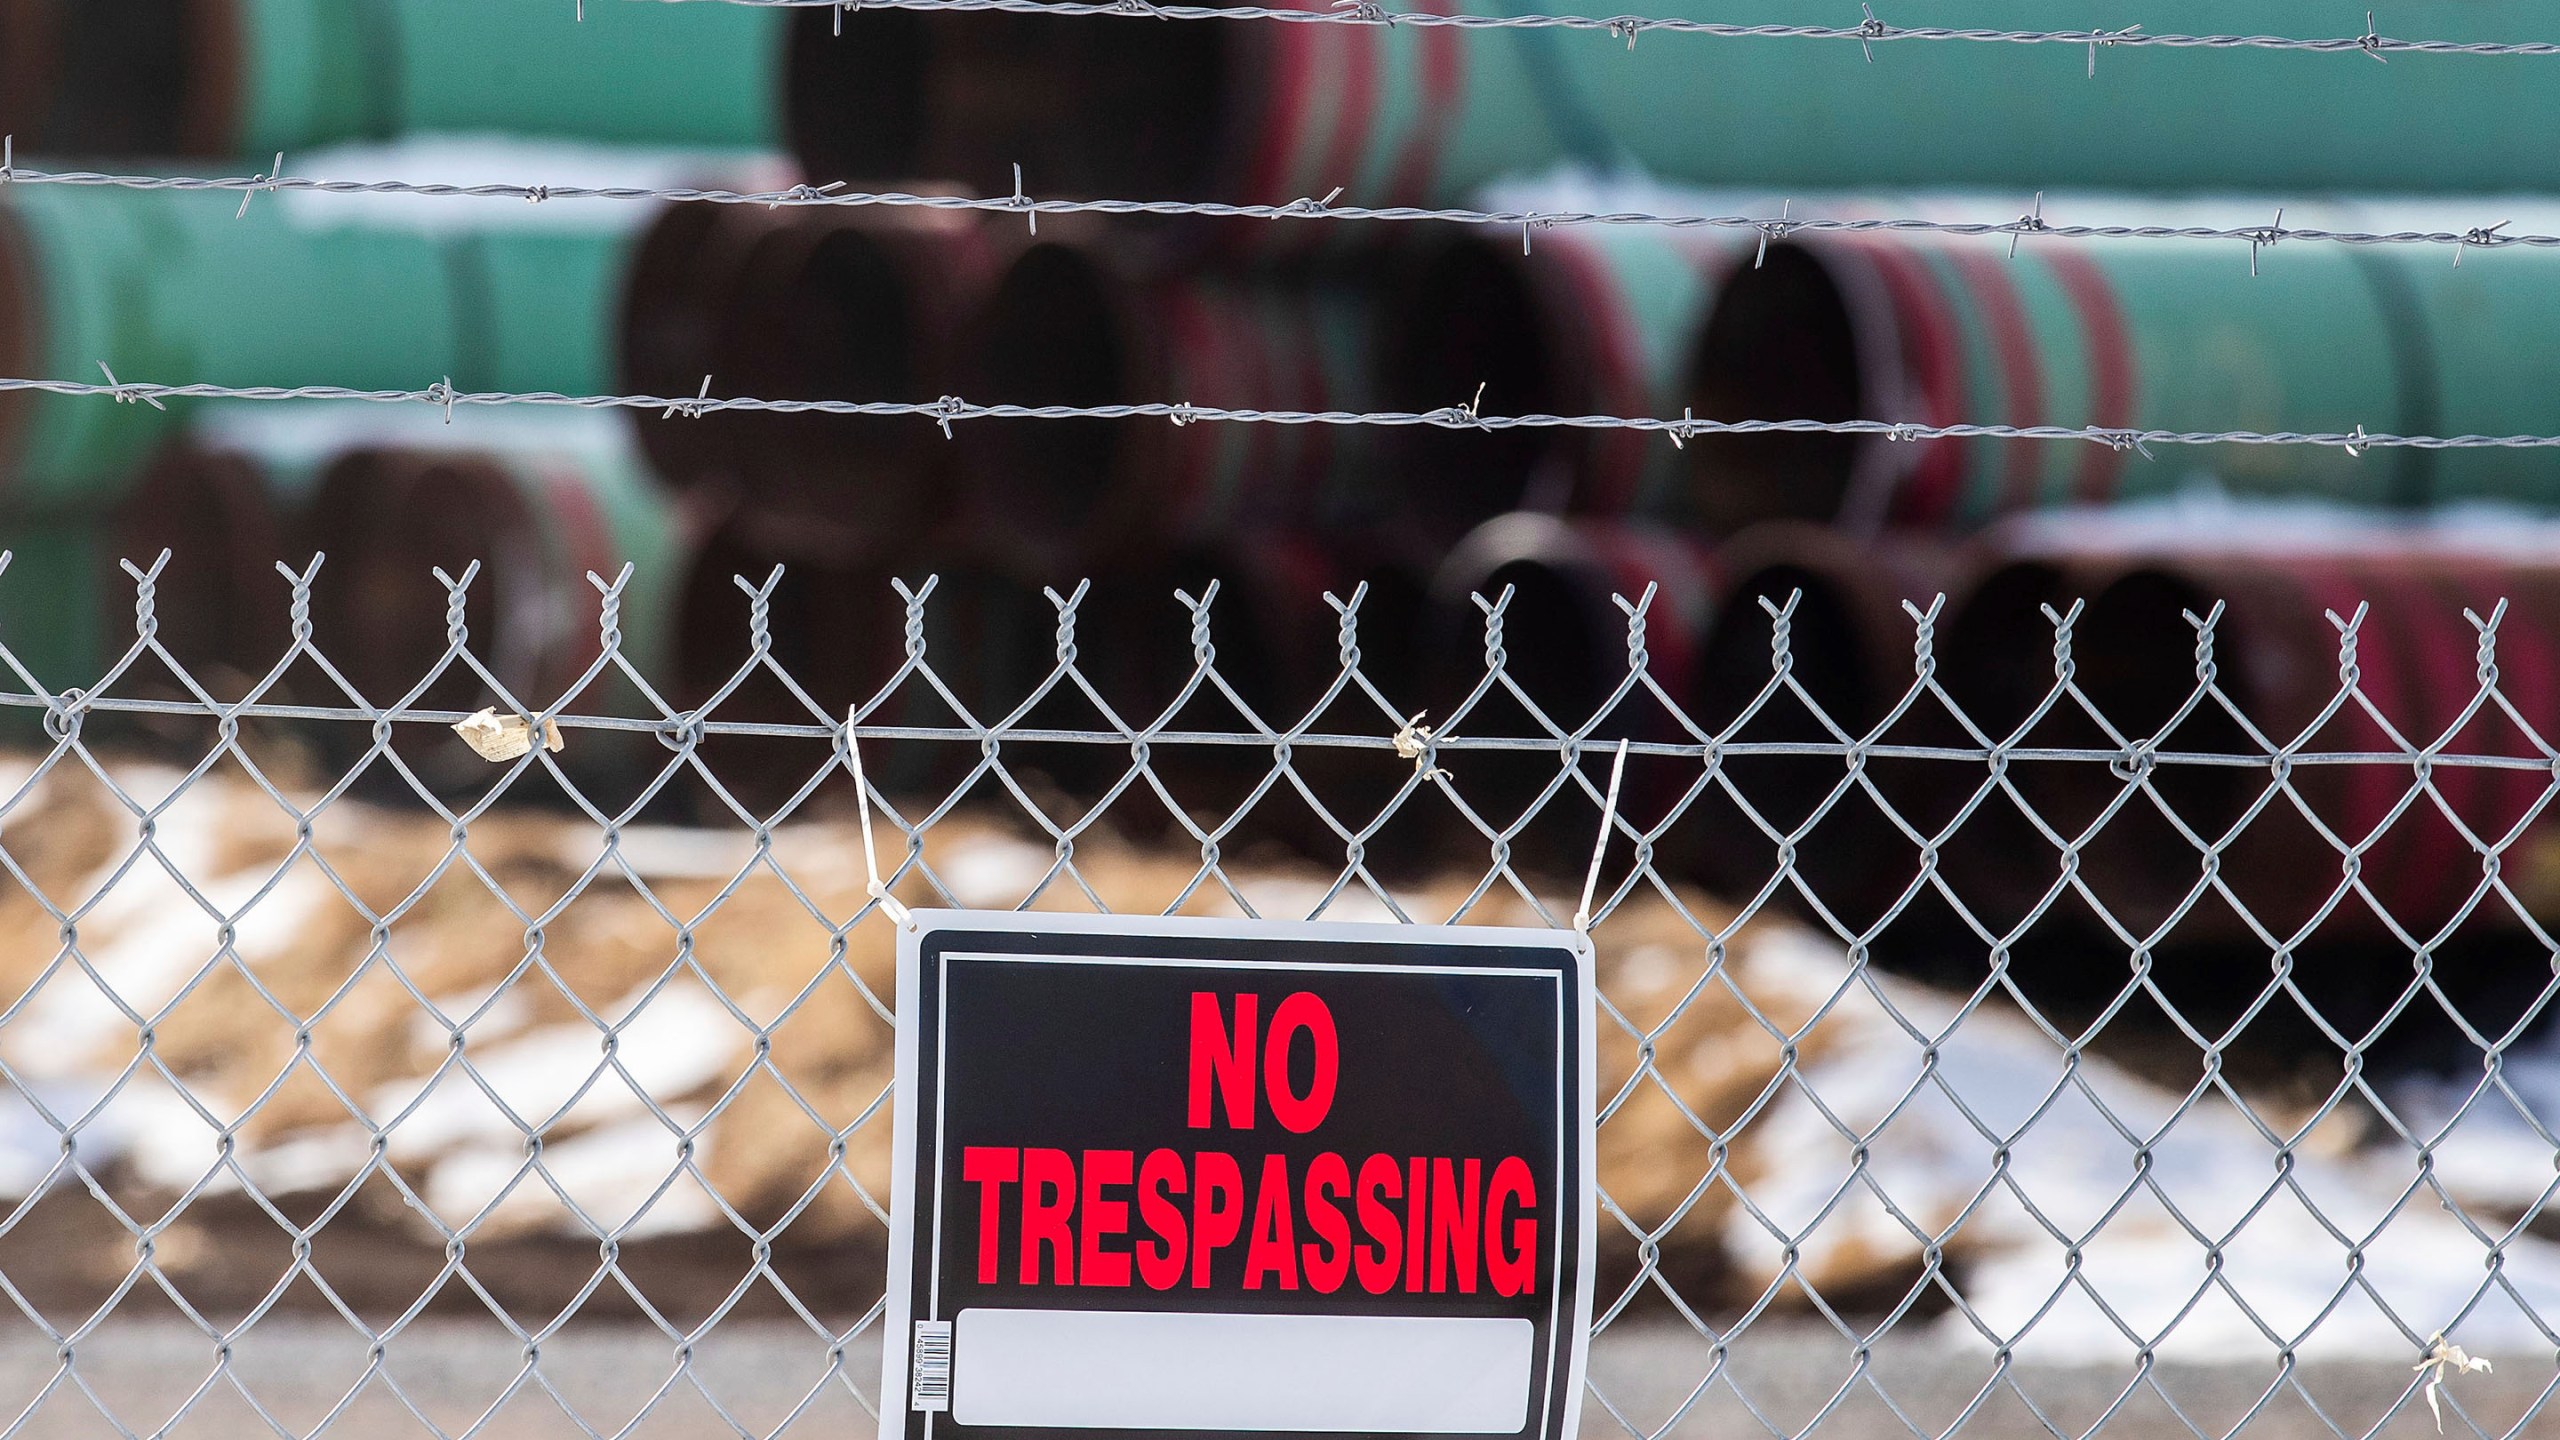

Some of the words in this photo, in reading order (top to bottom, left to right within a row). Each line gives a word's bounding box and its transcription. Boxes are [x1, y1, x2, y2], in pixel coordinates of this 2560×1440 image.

[1188, 992, 1338, 1133] NO
[964, 1147, 1537, 1297] TRESPASSING
[914, 1367, 923, 1392] 38242
[915, 1338, 924, 1364] 45899
